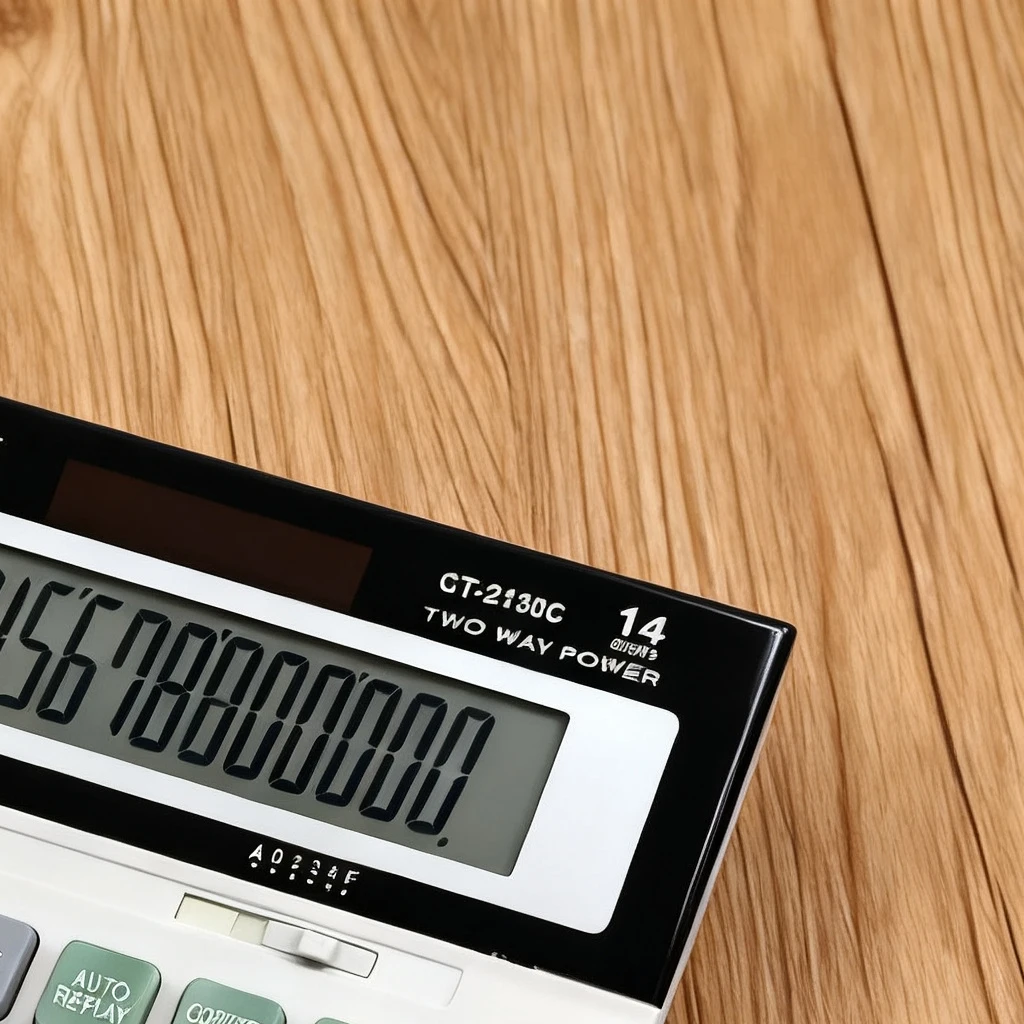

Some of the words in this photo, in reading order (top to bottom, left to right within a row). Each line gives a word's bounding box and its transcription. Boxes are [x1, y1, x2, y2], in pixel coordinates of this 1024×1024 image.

[424, 605, 486, 636] TWO
[496, 626, 554, 656] WAY
[559, 645, 661, 687] POWER
[620, 606, 667, 646] 14
[71, 969, 132, 1002] AUTO
